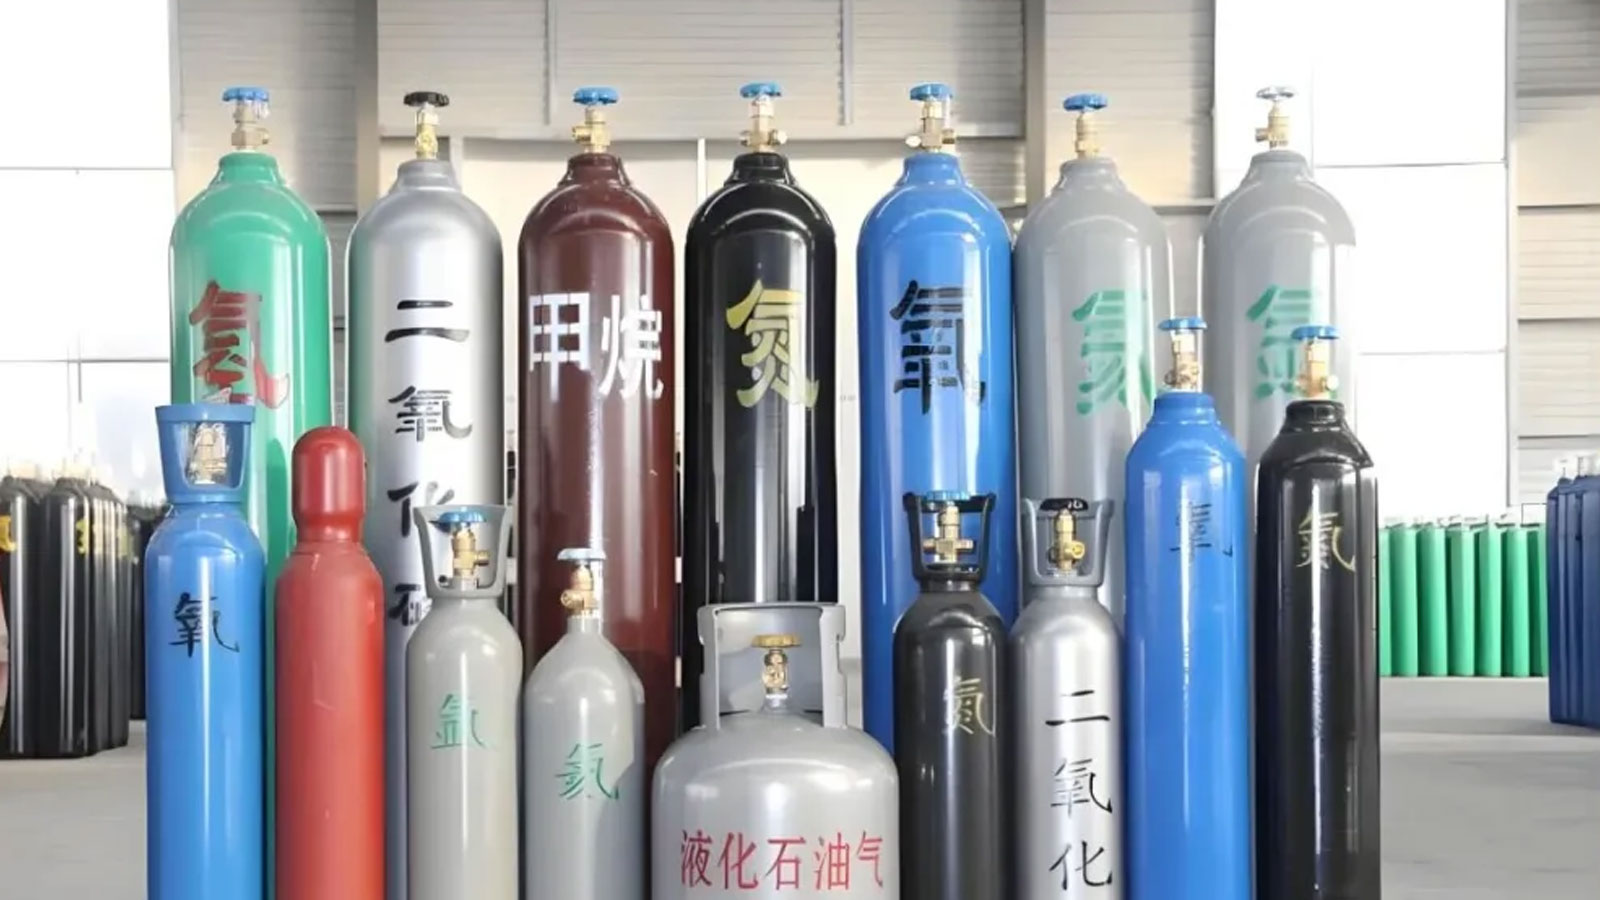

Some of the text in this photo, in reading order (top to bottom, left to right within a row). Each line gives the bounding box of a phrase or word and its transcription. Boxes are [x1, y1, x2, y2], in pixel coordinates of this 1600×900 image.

[189, 280, 290, 409] 氢
[528, 292, 664, 400] 甲烷
[726, 278, 820, 408] 氮
[889, 279, 987, 415] 氧
[168, 592, 240, 658] 氧
[431, 694, 490, 750] 氩
[555, 743, 619, 801] 氦
[680, 829, 884, 891] 液化石油气
